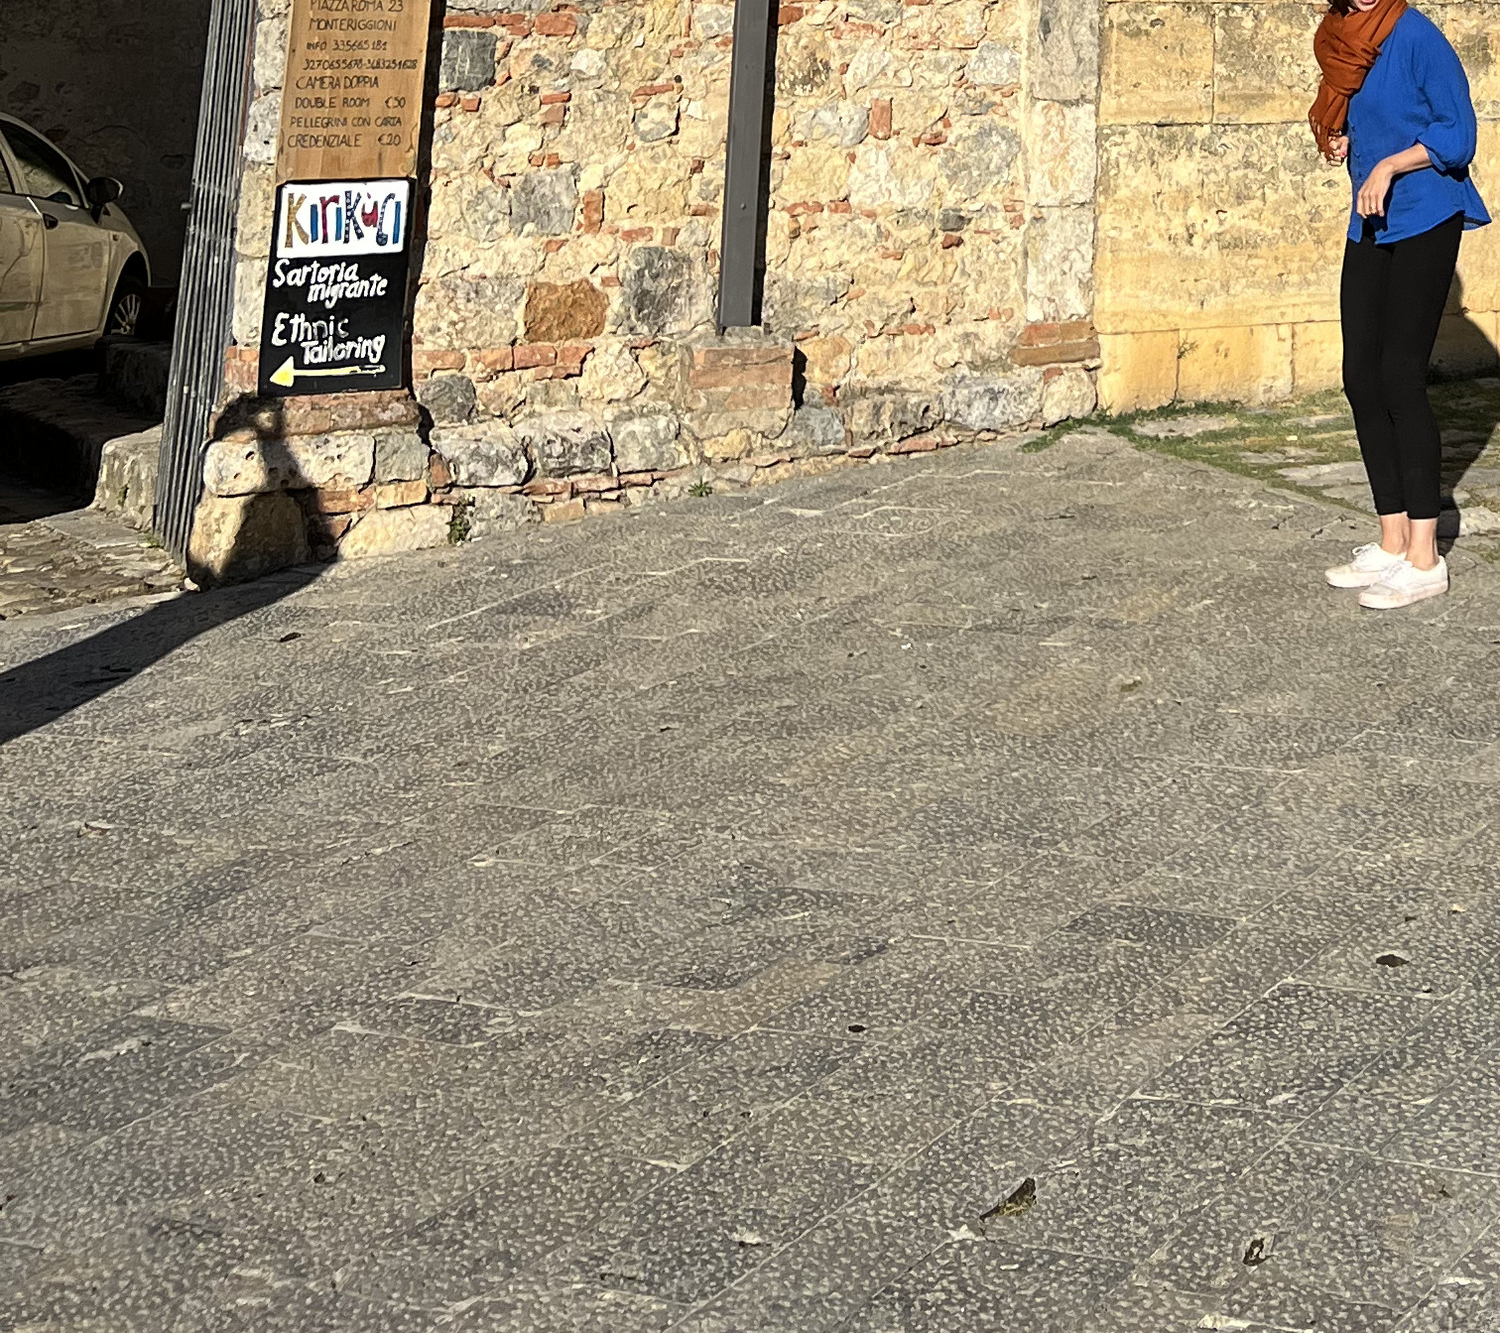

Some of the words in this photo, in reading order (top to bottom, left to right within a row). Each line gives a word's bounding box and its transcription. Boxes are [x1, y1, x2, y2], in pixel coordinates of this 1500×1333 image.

[308, 18, 397, 31] MONTERIGGIONI
[306, 41, 327, 51] INFO
[296, 75, 340, 90] CAMERA
[343, 75, 379, 90] DOPPIA
[295, 96, 337, 109] DOUBLE
[342, 96, 370, 108] ROOM
[384, 96, 406, 109] €50
[290, 116, 348, 129] PELLEGRINI
[351, 116, 371, 127] CON
[374, 116, 402, 128] CARTA
[287, 133, 363, 148] CREDENZIALE
[377, 133, 402, 146] €20
[272, 258, 360, 288] Sartoria
[307, 273, 389, 309] migrante
[271, 311, 350, 347] Ethnic
[300, 334, 386, 365] Tailoring
